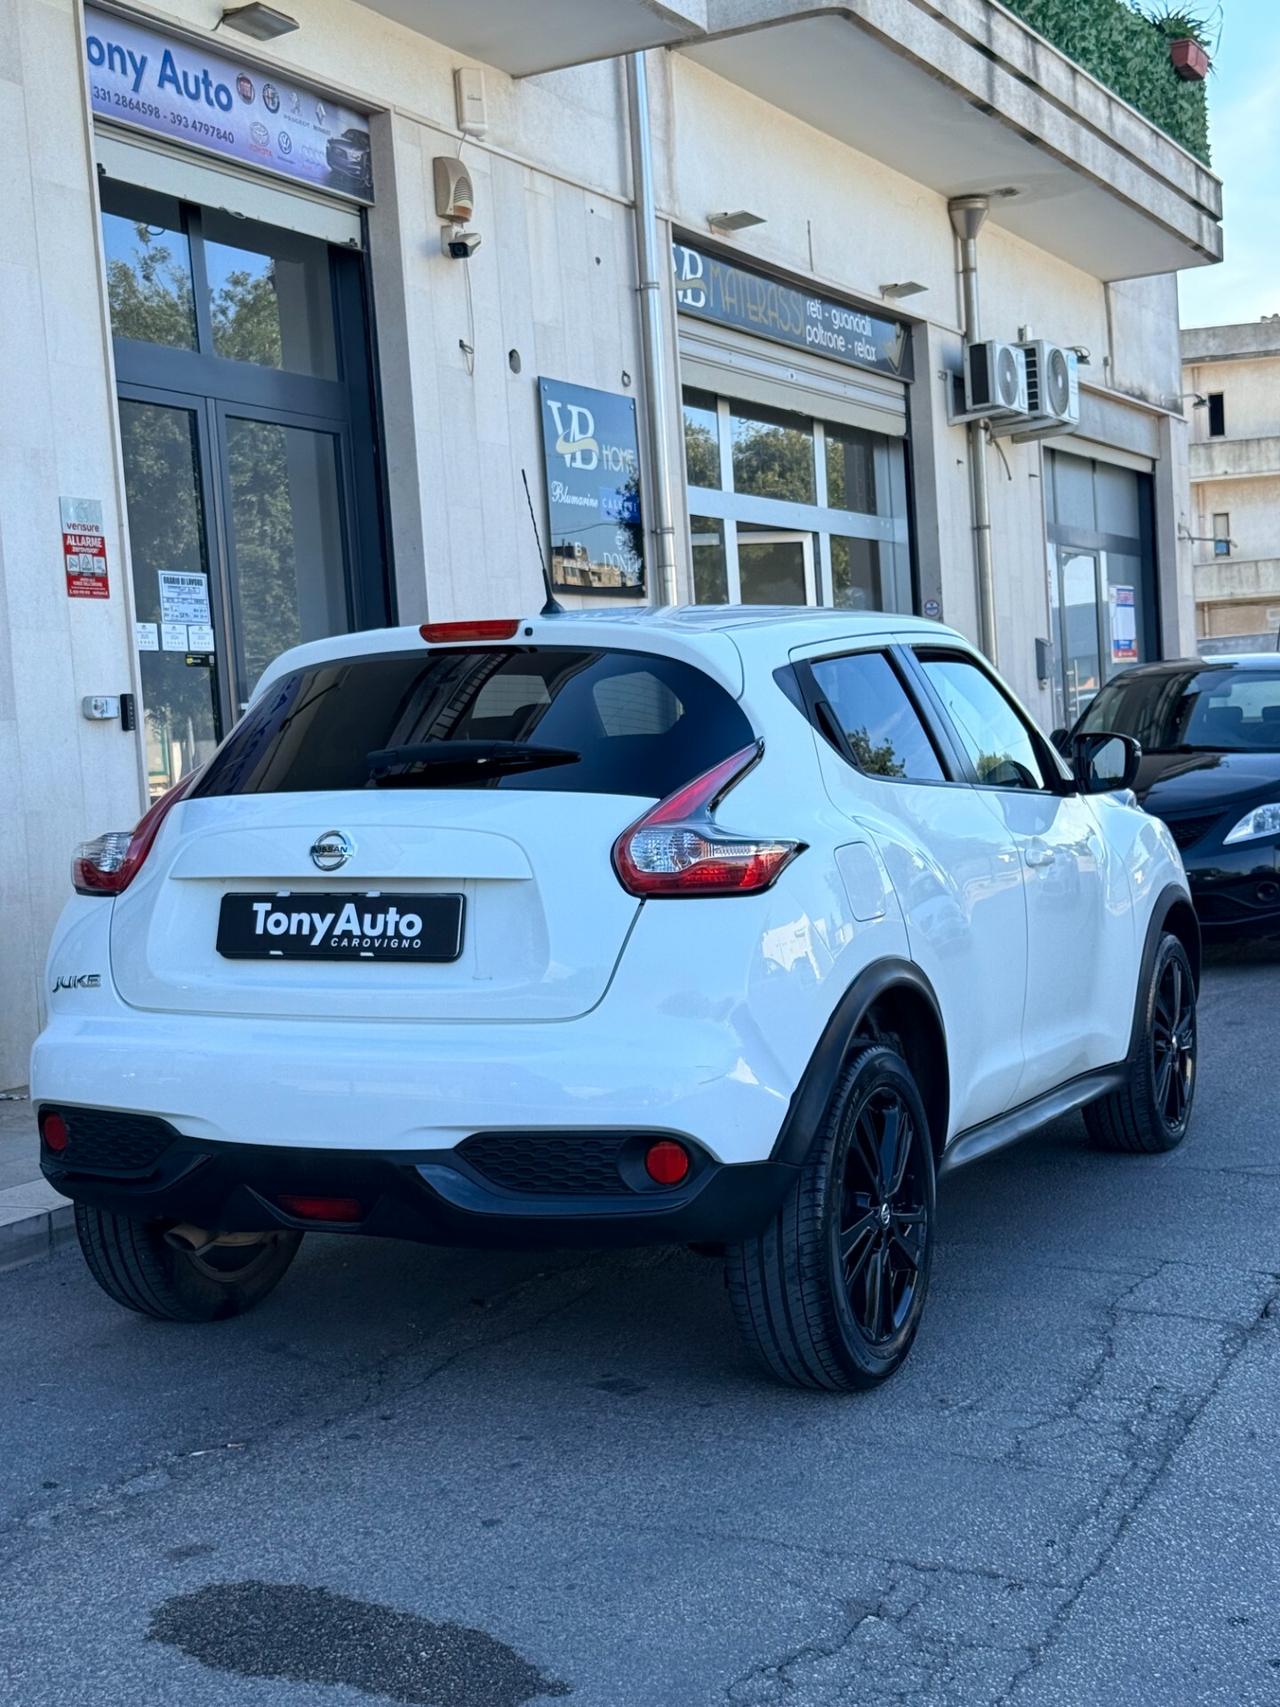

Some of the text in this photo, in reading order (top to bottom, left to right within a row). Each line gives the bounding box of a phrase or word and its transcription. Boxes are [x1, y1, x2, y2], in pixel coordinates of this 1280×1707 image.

[86, 35, 233, 112] ony Auto
[93, 86, 112, 103] 331
[114, 92, 161, 119] 2864598
[170, 112, 189, 128] 393
[191, 120, 235, 144] 4797840
[710, 263, 806, 338] MATERASSI
[806, 299, 823, 320] reti
[831, 309, 873, 338] guanciali
[805, 322, 846, 352] poltrone
[854, 337, 878, 362] relax
[602, 444, 634, 473] HOME
[66, 522, 100, 533] verisure
[66, 534, 103, 548] ALLARME
[252, 902, 423, 946] TonyAuto
[330, 938, 422, 948] CAROVIGNO
[52, 974, 102, 993] JUKE
